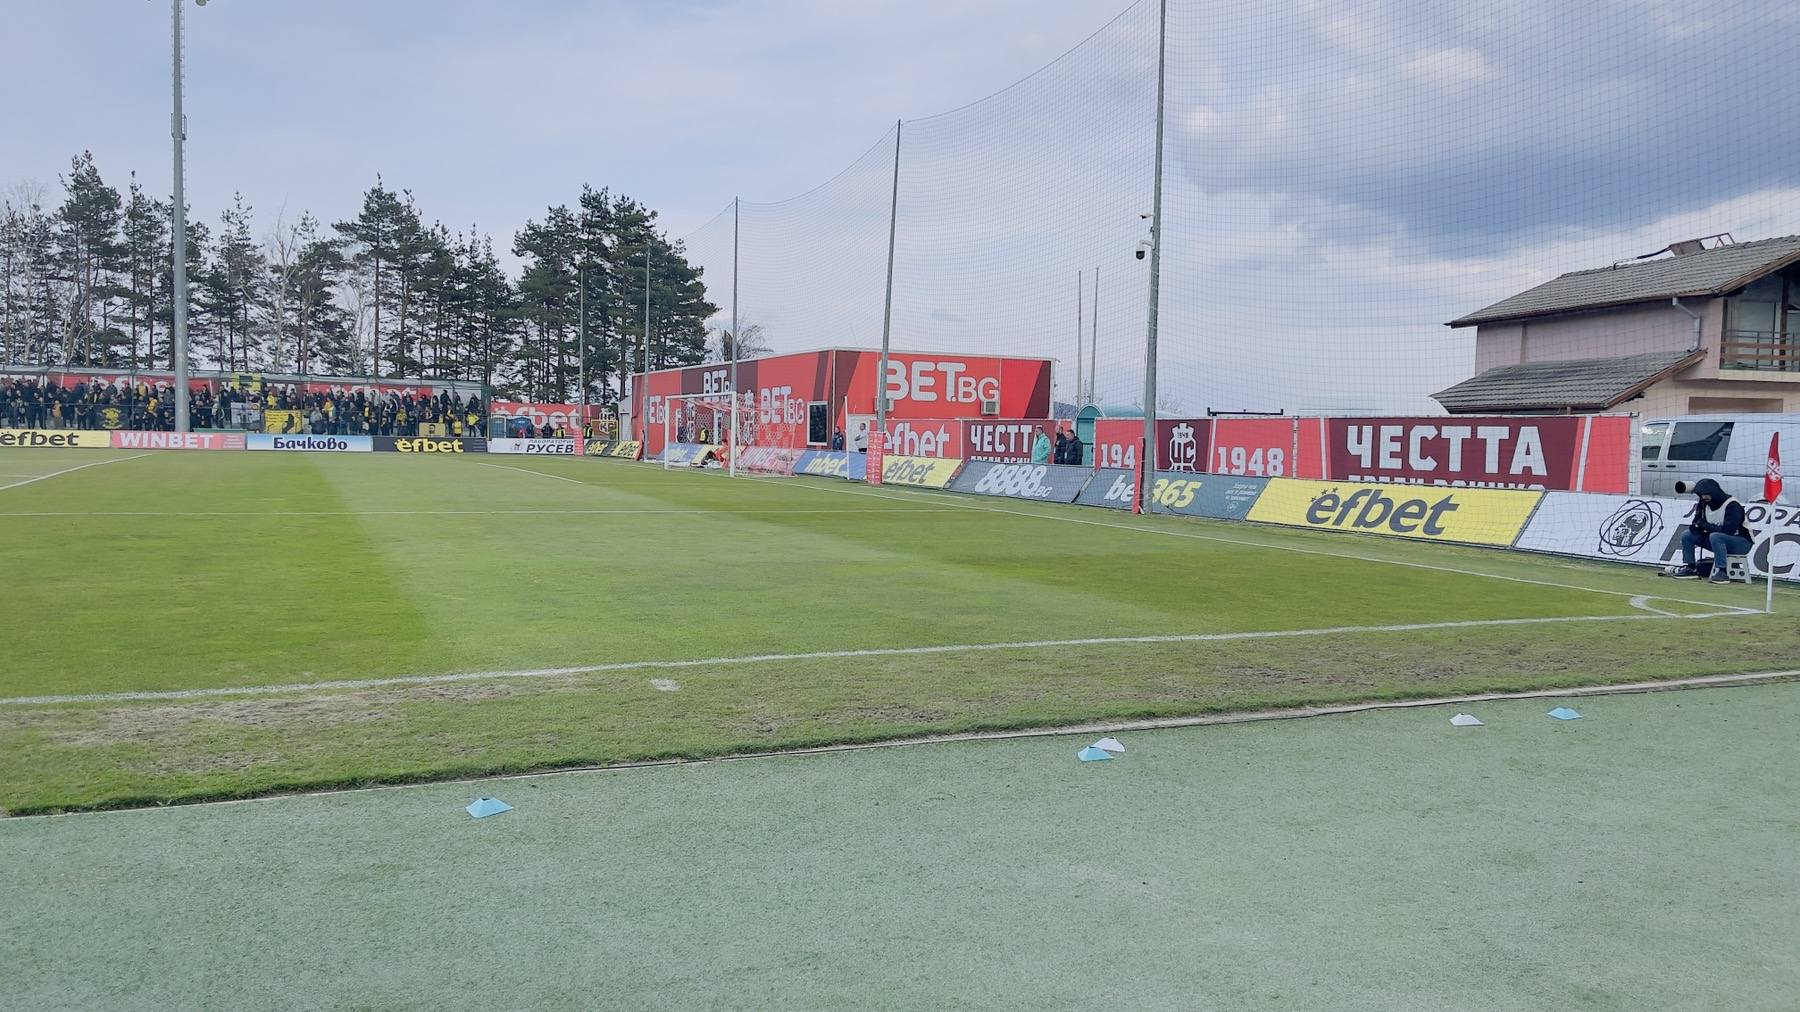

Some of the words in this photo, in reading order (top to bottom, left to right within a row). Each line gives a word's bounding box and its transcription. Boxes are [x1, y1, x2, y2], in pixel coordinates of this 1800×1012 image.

[0, 431, 79, 446] efbet
[120, 431, 214, 449] WINBET
[273, 436, 348, 451] Бачково
[395, 438, 464, 453] efbet
[526, 444, 574, 453] РУСЕВ
[970, 424, 1042, 453] ЧЕСТТ
[1347, 425, 1547, 476] ЧЕСТТА
[1101, 443, 1135, 469] 194
[1218, 446, 1285, 477] 1948
[884, 460, 935, 484] efbet
[1104, 474, 1203, 508] be365
[1305, 487, 1460, 536] efbet
